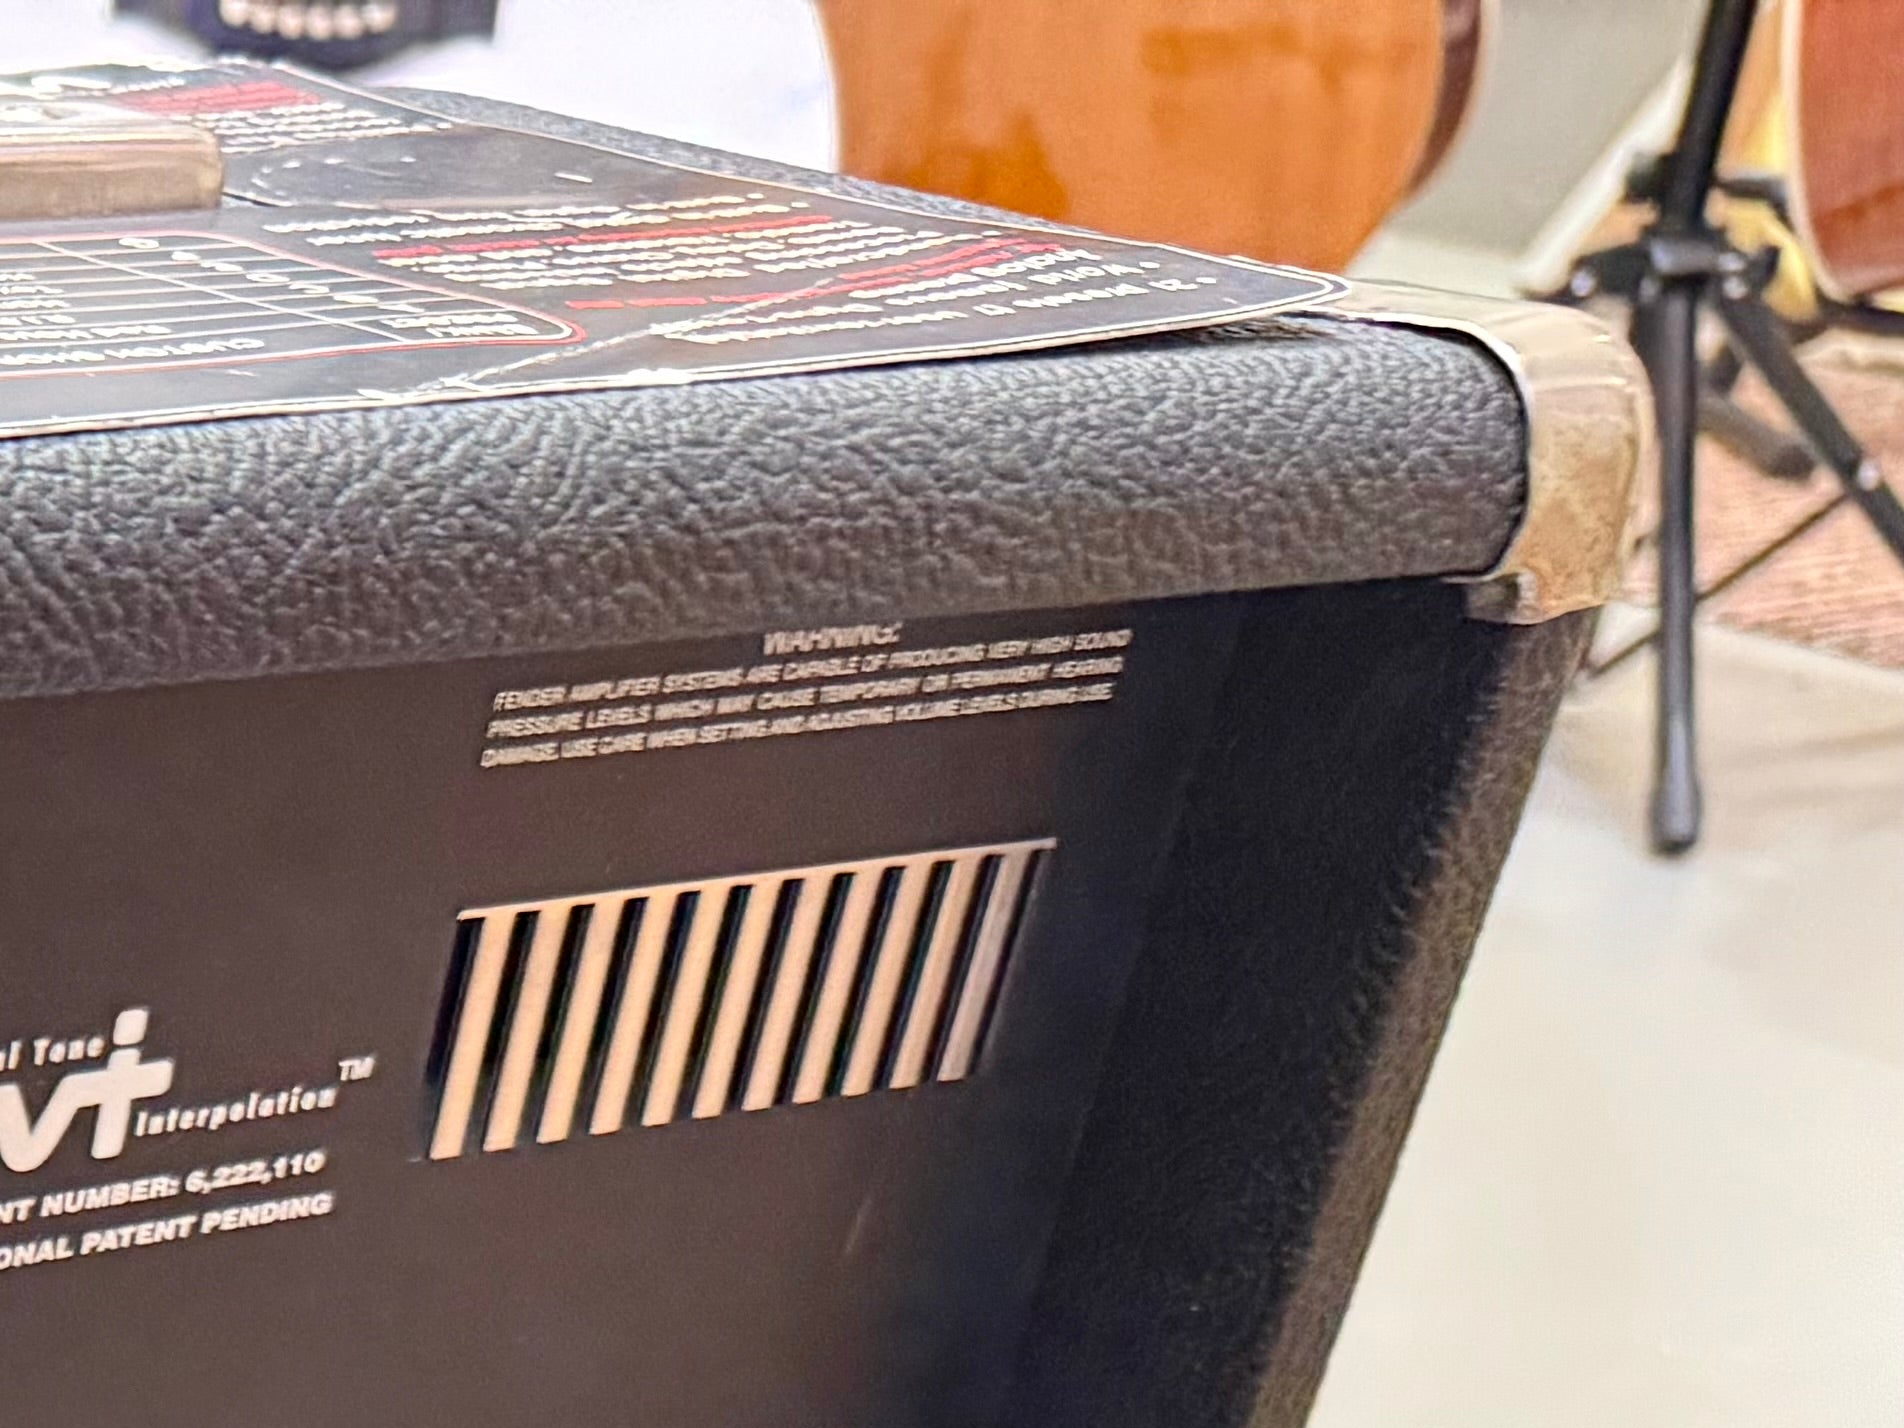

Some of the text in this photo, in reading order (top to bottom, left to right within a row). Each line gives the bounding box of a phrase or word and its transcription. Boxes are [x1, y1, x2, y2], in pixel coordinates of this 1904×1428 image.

[1028, 264, 1145, 285] World
[32, 1035, 105, 1066] Tone
[38, 1173, 181, 1218] NUMBER:
[78, 1213, 199, 1256] PATENT
[198, 1190, 334, 1235] PENDING
